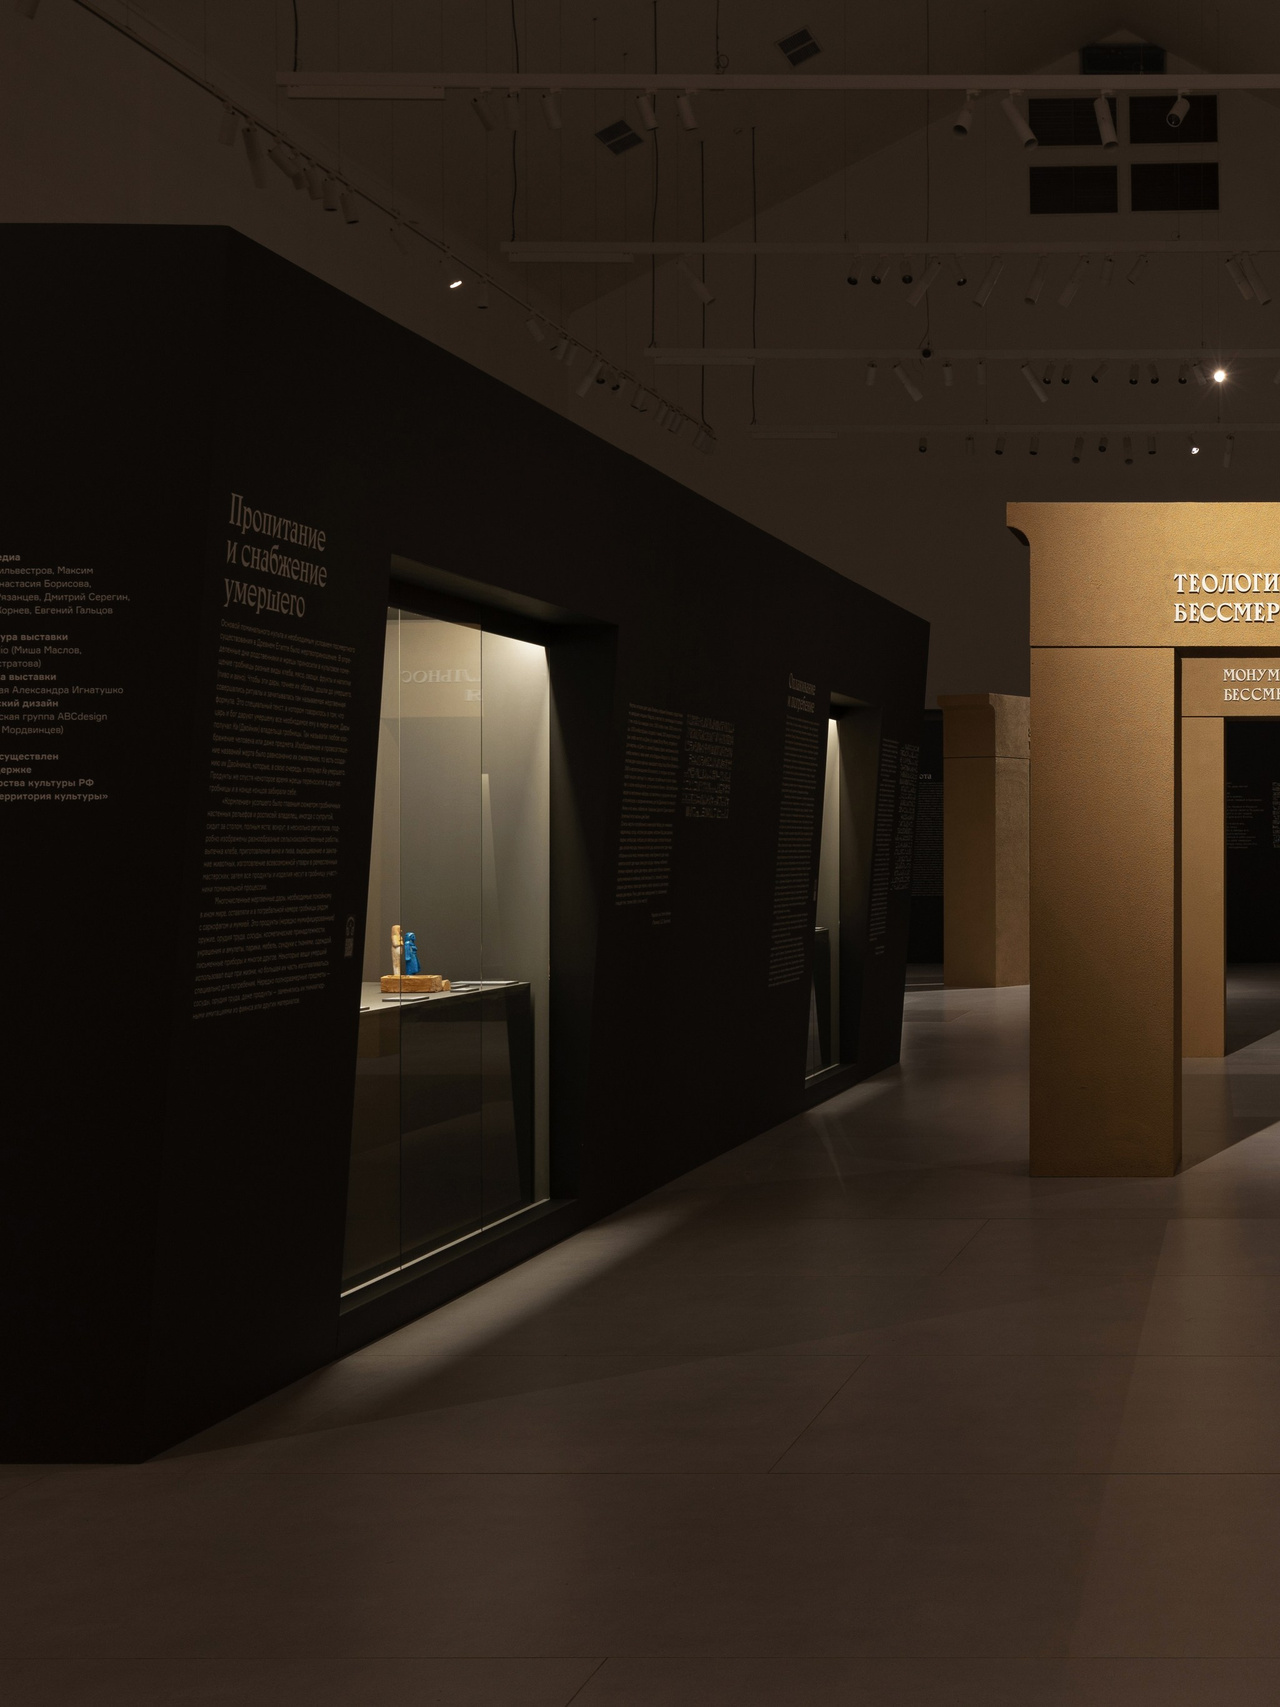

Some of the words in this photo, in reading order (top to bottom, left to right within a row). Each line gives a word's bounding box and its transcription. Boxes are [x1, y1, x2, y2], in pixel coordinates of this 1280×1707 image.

[229, 492, 327, 552] Пропитание
[226, 540, 238, 564] и
[241, 544, 328, 588] снабжение
[58, 565, 93, 574] Максим
[44, 580, 91, 589] Борисова,
[0, 593, 41, 601] язанцев,
[44, 593, 85, 602] Дмитрий
[88, 593, 130, 602] Серегин,
[223, 578, 306, 618] умершего
[35, 605, 73, 614] Евгений
[76, 606, 113, 615] Гальцов
[0, 634, 17, 642] ура
[11, 646, 41, 655] (Миша
[44, 645, 81, 654] Маслов,
[12, 686, 69, 695] Александра
[72, 686, 123, 695] Игнатушко
[0, 698, 19, 707] кий
[22, 699, 58, 708] дизайн
[23, 713, 54, 722] группа
[58, 712, 107, 722] ABCdesign
[2, 726, 63, 735] Мордвинцев)
[0, 767, 32, 775] ержке
[28, 780, 75, 788] культуры
[55, 793, 108, 801] культуры»
